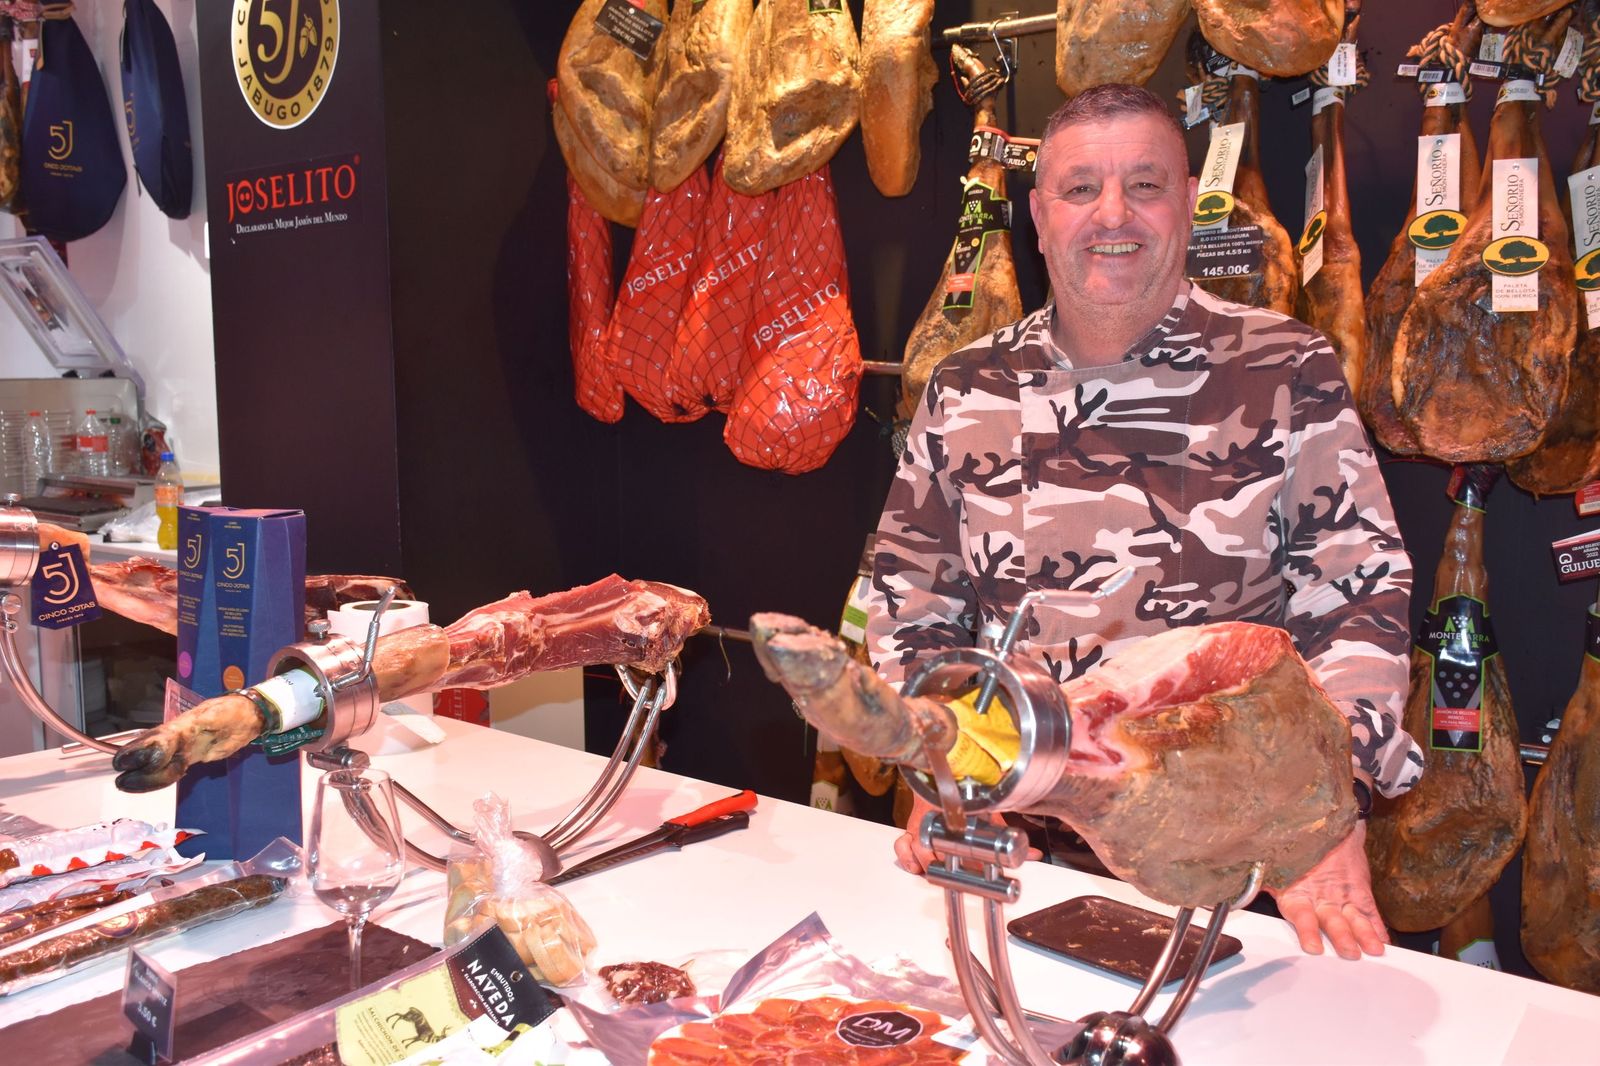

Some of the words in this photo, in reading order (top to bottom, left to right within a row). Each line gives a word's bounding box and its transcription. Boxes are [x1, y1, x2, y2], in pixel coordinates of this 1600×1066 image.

[239, 56, 301, 120] JABUGO
[306, 36, 335, 103] 1879
[48, 120, 73, 160] 5J
[226, 164, 356, 224] JOSELITO
[1187, 243, 1208, 251] PALETA
[1202, 264, 1250, 277] 145.00€
[751, 283, 840, 350] JOSELITO
[184, 534, 203, 569] 5J
[222, 542, 245, 579] 5J
[1560, 559, 1600, 574] GUIJUE
[42, 552, 79, 604] 5J
[38, 608, 68, 621] CINCO
[68, 601, 96, 614] JOTAS
[1428, 631, 1491, 643] MONTEARRA
[466, 959, 516, 1027] NAVEDA
[490, 967, 515, 1002] EMBUTIDOS
[852, 1016, 913, 1040] DM
